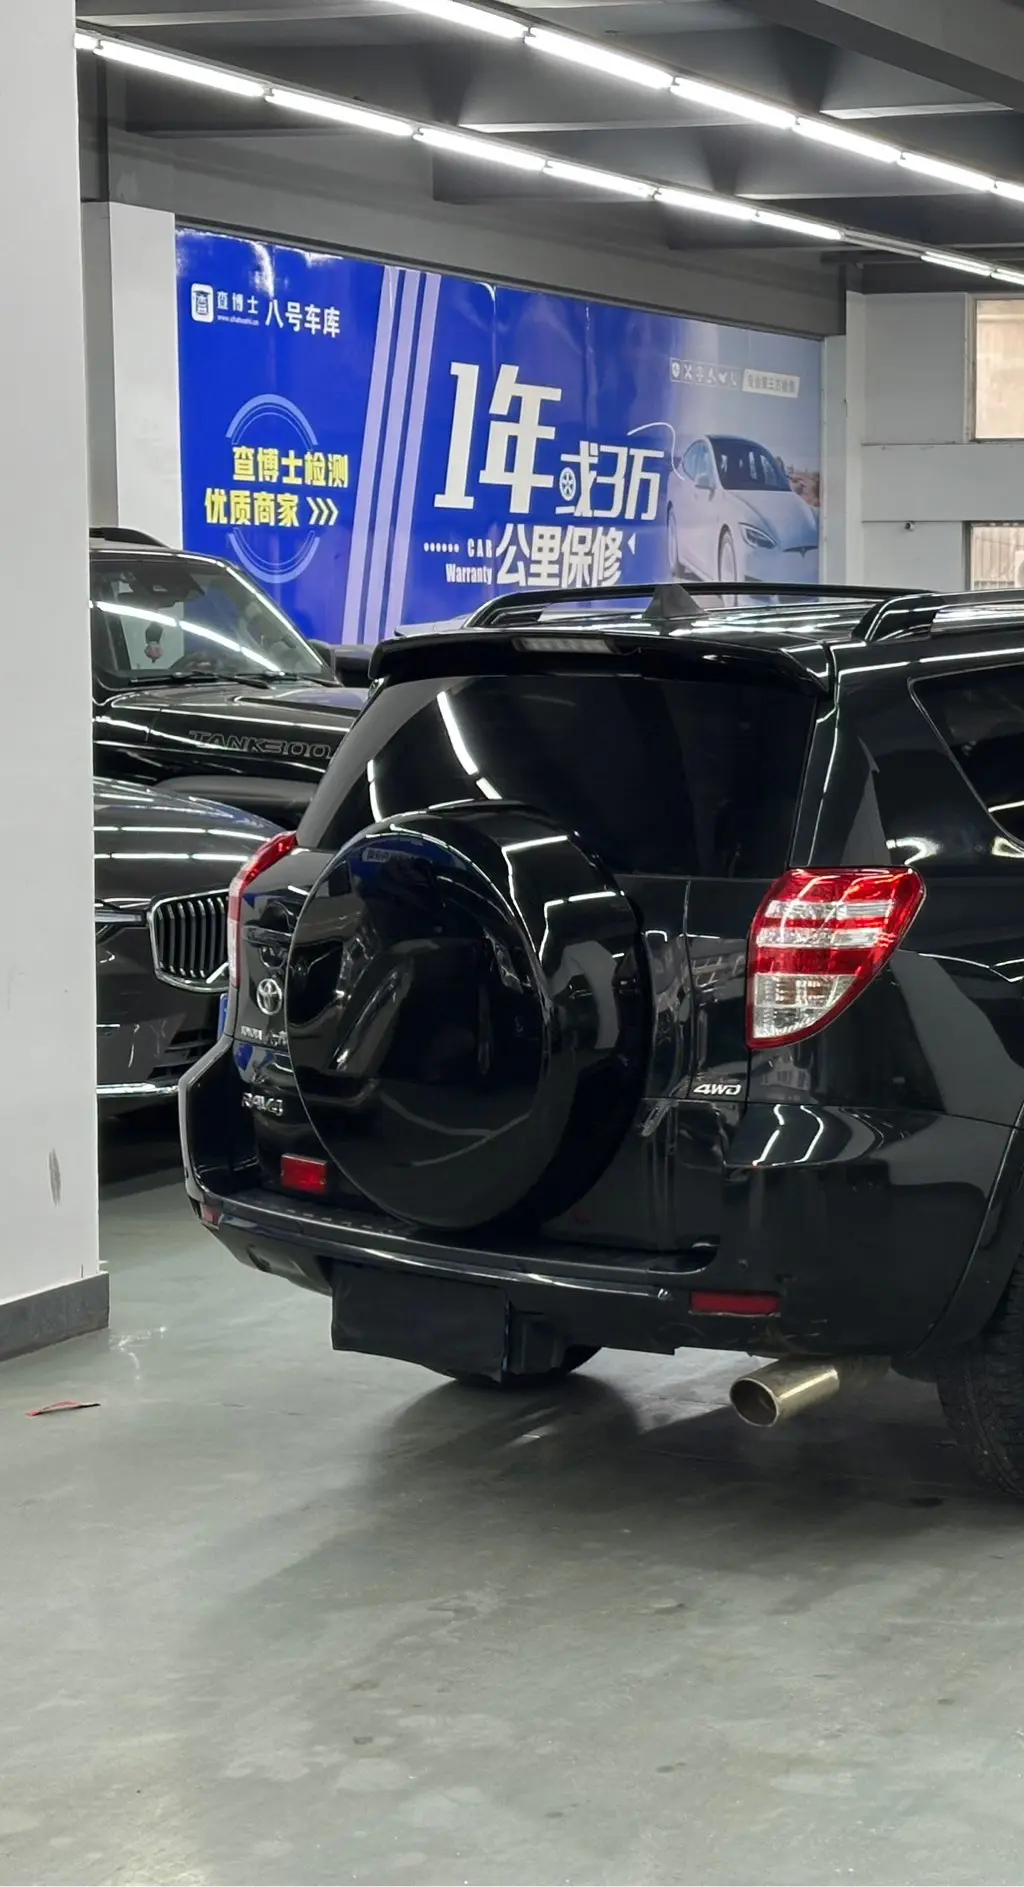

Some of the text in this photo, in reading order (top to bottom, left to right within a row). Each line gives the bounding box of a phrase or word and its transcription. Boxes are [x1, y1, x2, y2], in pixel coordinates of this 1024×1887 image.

[217, 290, 259, 315] 查博士
[265, 298, 341, 338] 八号车库
[232, 445, 350, 489] 查博士检测
[204, 487, 300, 528] 优质商家
[467, 538, 493, 558] CAR
[495, 523, 624, 588] 公里保修
[445, 563, 493, 585] Warranty
[693, 1082, 742, 1096] 4WD
[241, 1091, 283, 1117] RAV4
